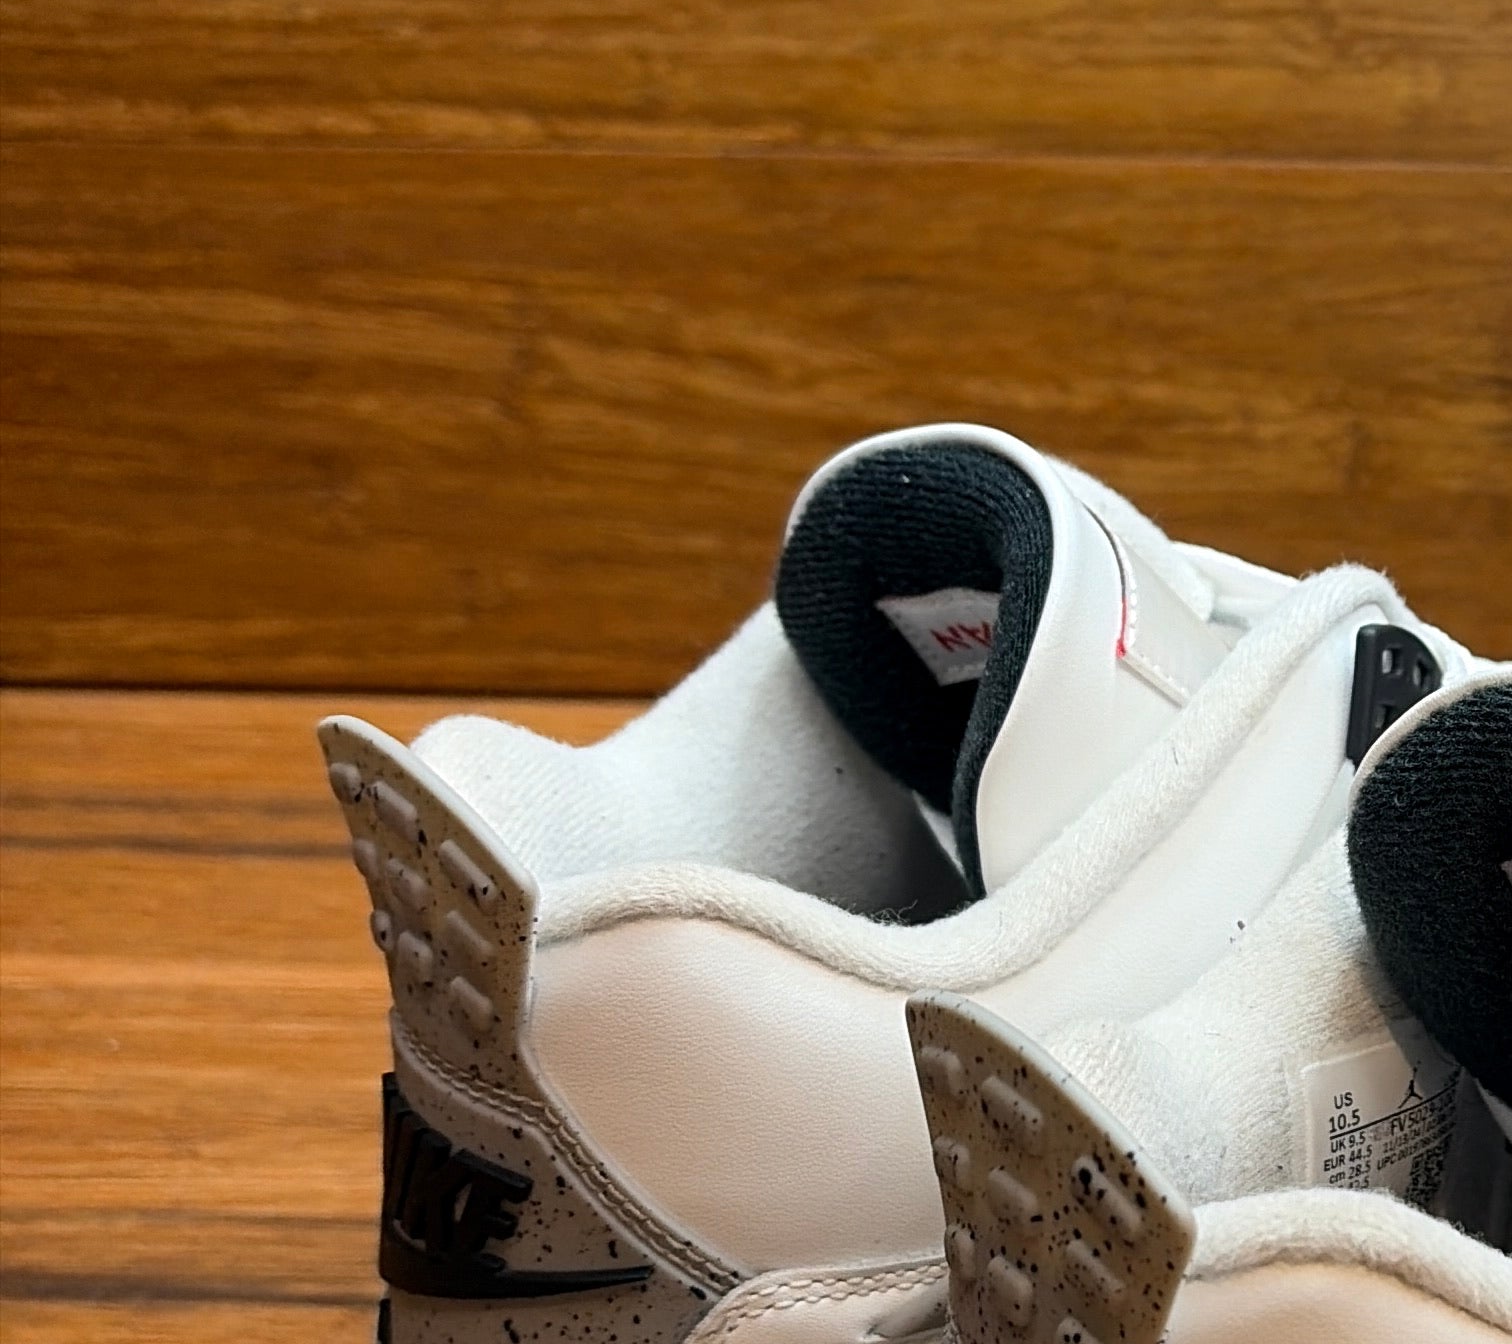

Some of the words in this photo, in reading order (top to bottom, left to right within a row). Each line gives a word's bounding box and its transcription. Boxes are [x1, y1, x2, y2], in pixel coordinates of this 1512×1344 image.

[1334, 1091, 1353, 1110] US
[1329, 1108, 1361, 1134] 10.5
[1330, 1137, 1346, 1153] UK
[1349, 1130, 1366, 1149] 9.5
[1323, 1154, 1346, 1173] EUR
[1349, 1144, 1373, 1164] 44.5
[1329, 1171, 1346, 1185] cm
[1348, 1160, 1371, 1181] 28.5
